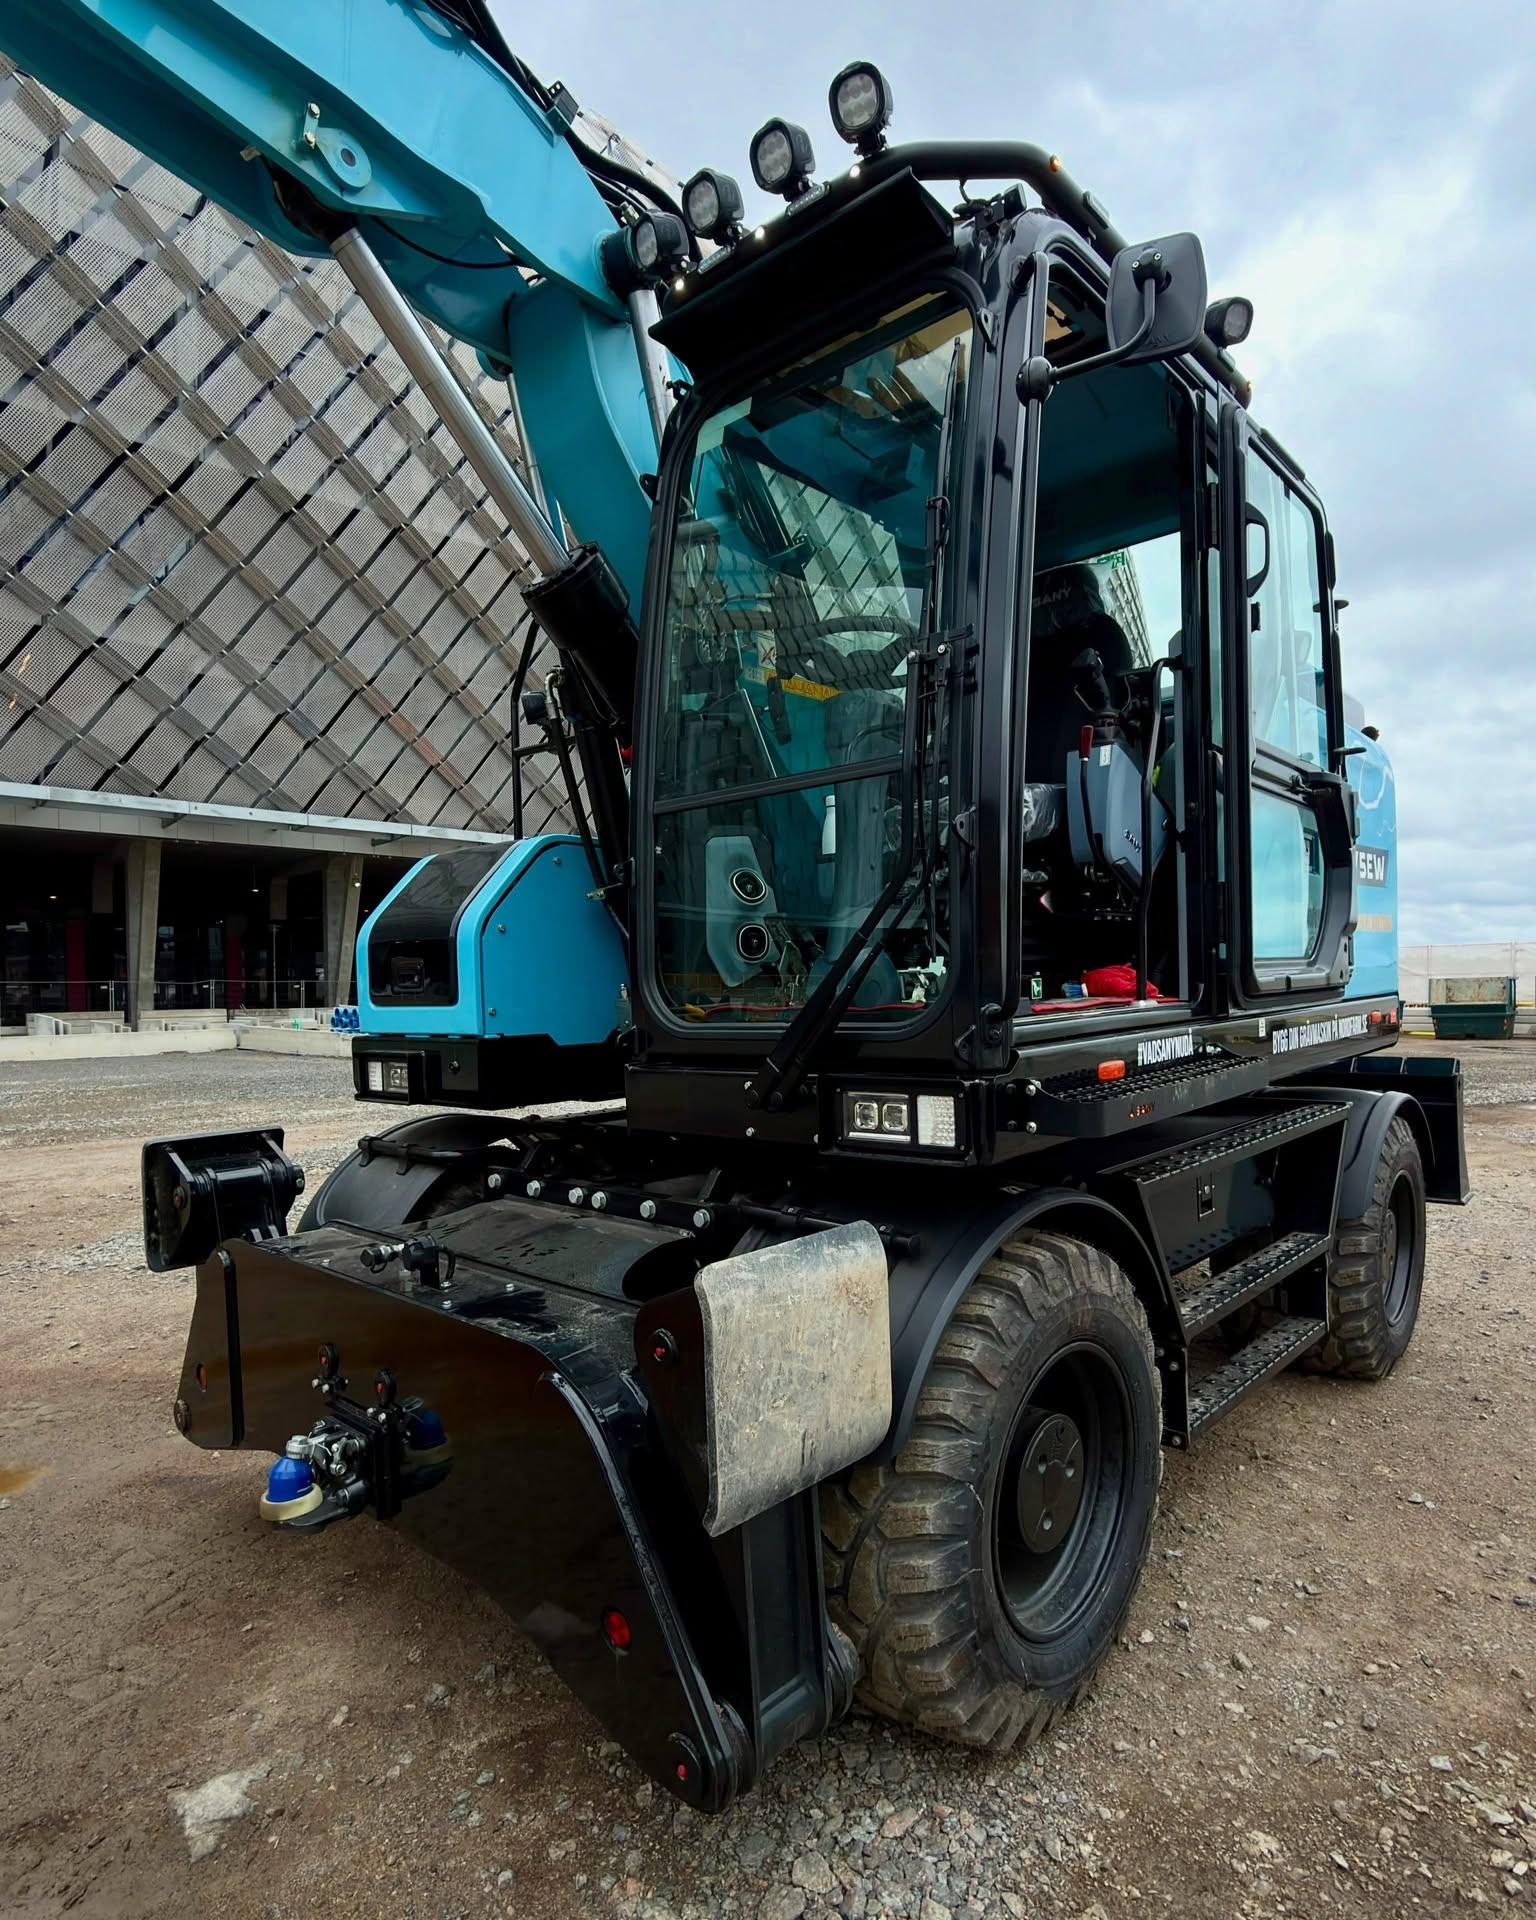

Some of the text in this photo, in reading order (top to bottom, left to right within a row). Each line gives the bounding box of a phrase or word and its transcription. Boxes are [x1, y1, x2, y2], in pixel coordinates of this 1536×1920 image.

[1137, 1027, 1194, 1067] #VADSANYNUDÅ
[1272, 1028, 1289, 1055] BYGG
[1288, 1026, 1299, 1051] DIN
[1331, 1013, 1339, 1041] PÅ
